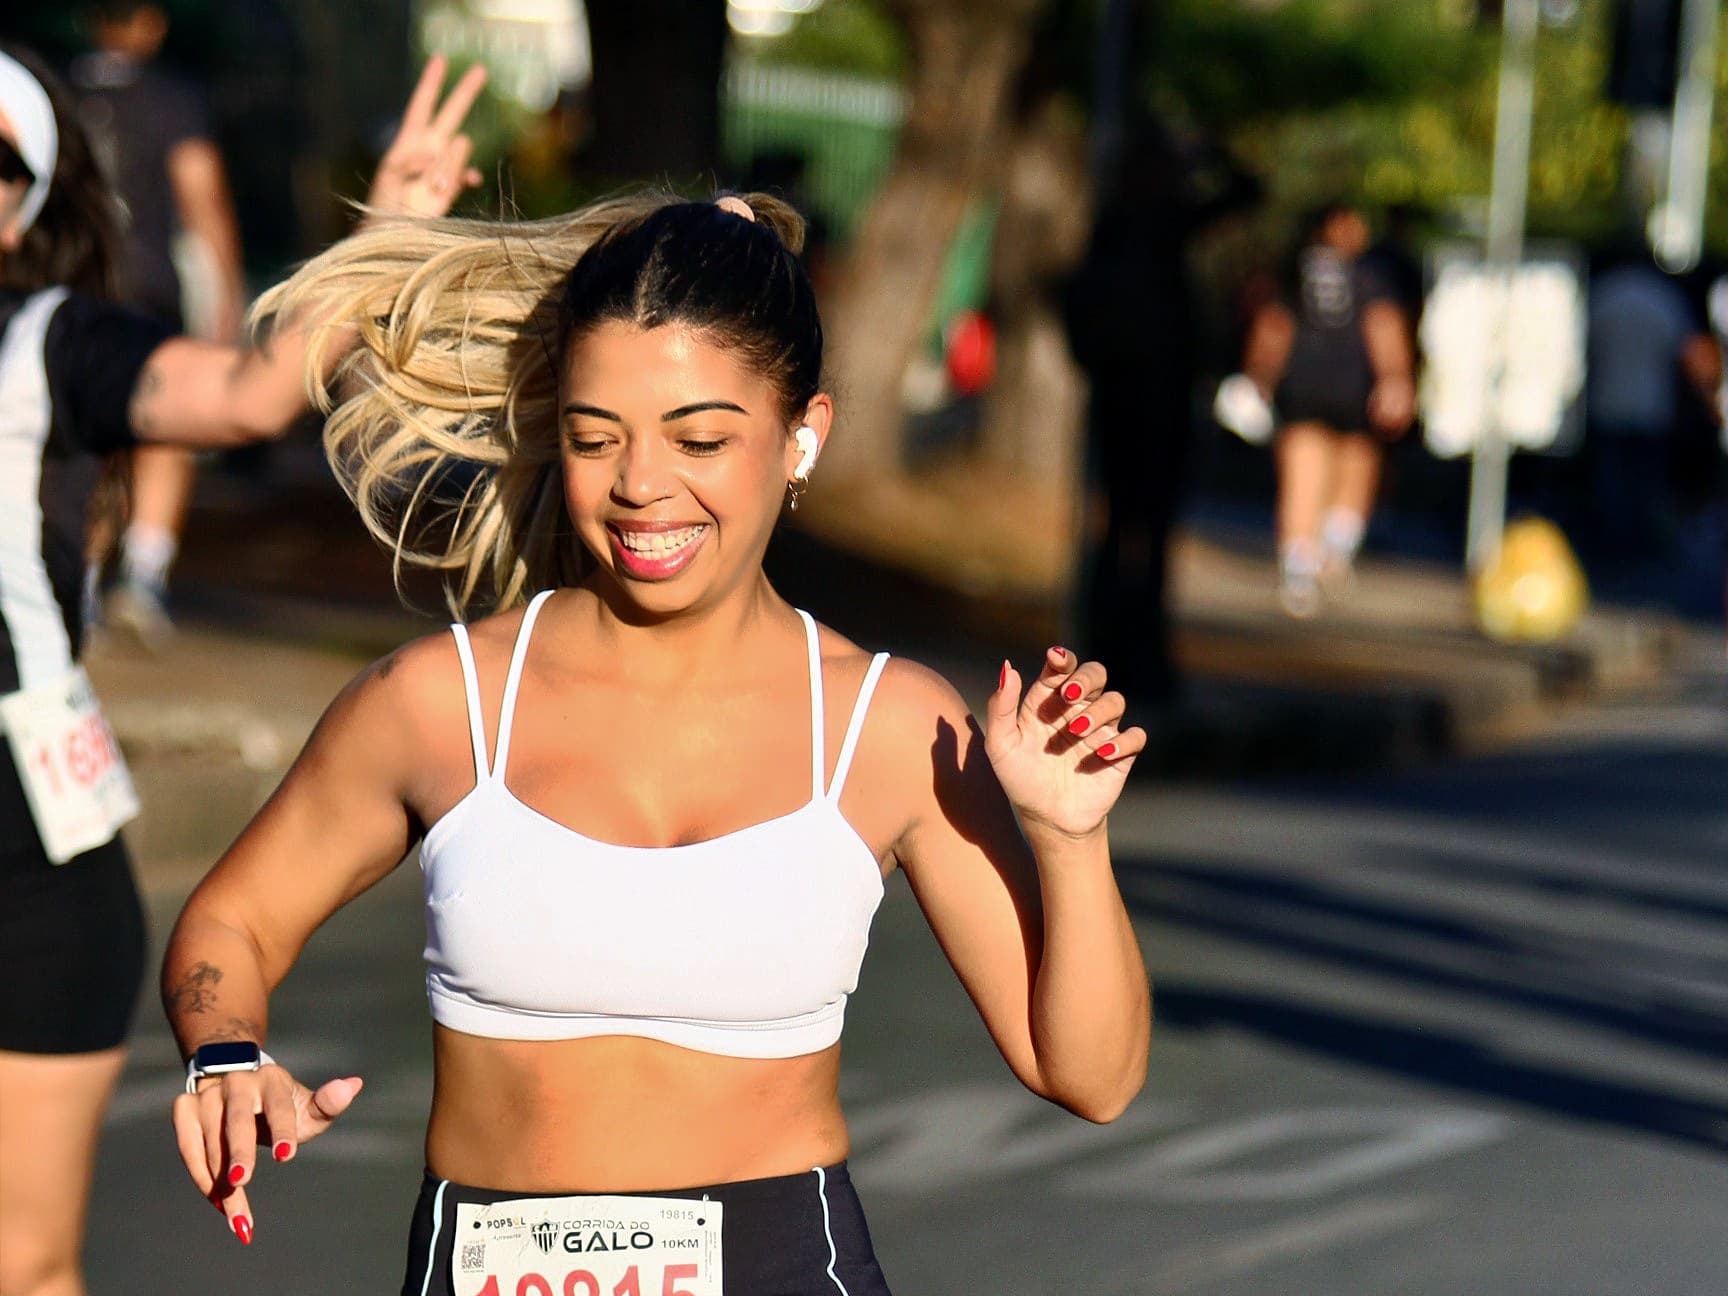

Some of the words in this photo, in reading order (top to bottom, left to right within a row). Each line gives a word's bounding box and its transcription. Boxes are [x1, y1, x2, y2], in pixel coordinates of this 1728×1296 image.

[660, 1209, 694, 1220] 19815
[563, 1219, 625, 1230] CORRIDA
[630, 1221, 650, 1230] DO
[563, 1231, 654, 1253] GALO
[662, 1238, 699, 1249] 10KM
